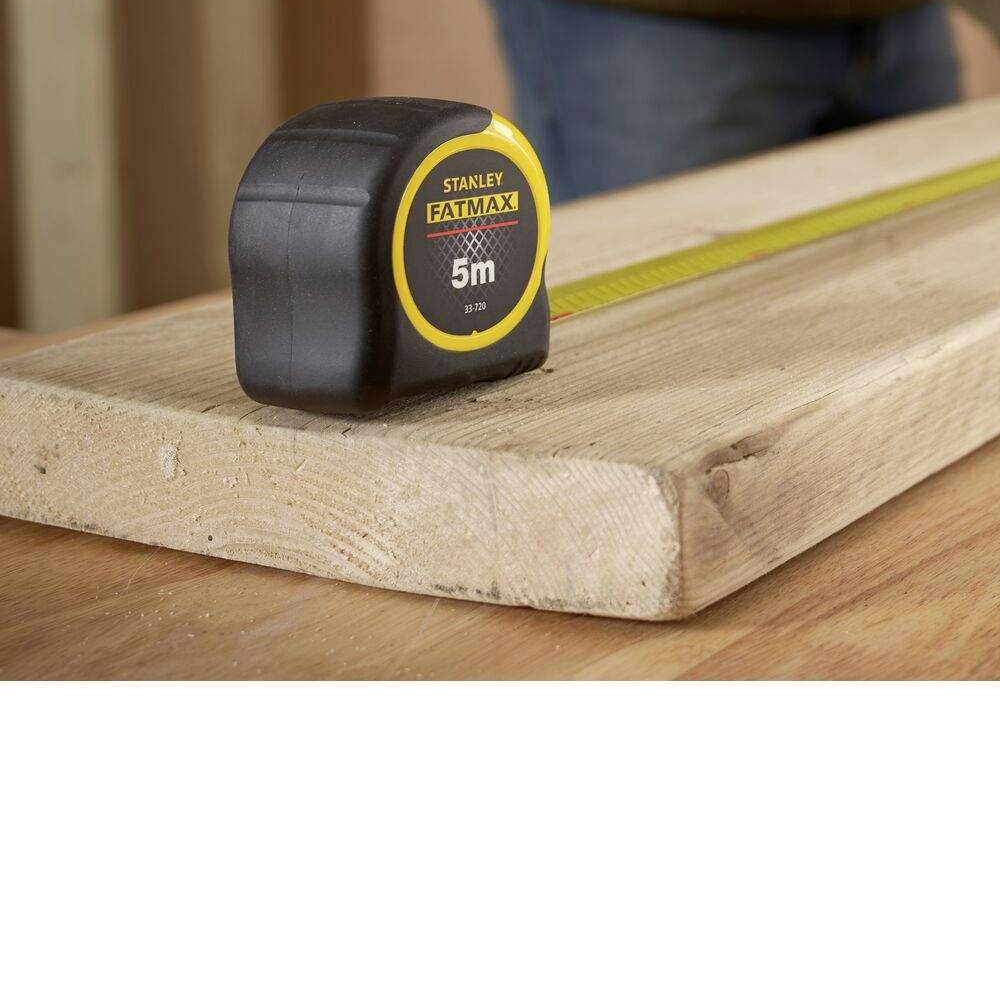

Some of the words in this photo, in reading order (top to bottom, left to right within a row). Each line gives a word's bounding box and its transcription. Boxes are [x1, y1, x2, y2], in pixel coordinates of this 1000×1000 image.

[443, 172, 503, 193] STANLEY
[452, 257, 495, 289] 5m
[464, 302, 487, 314] 33-720
